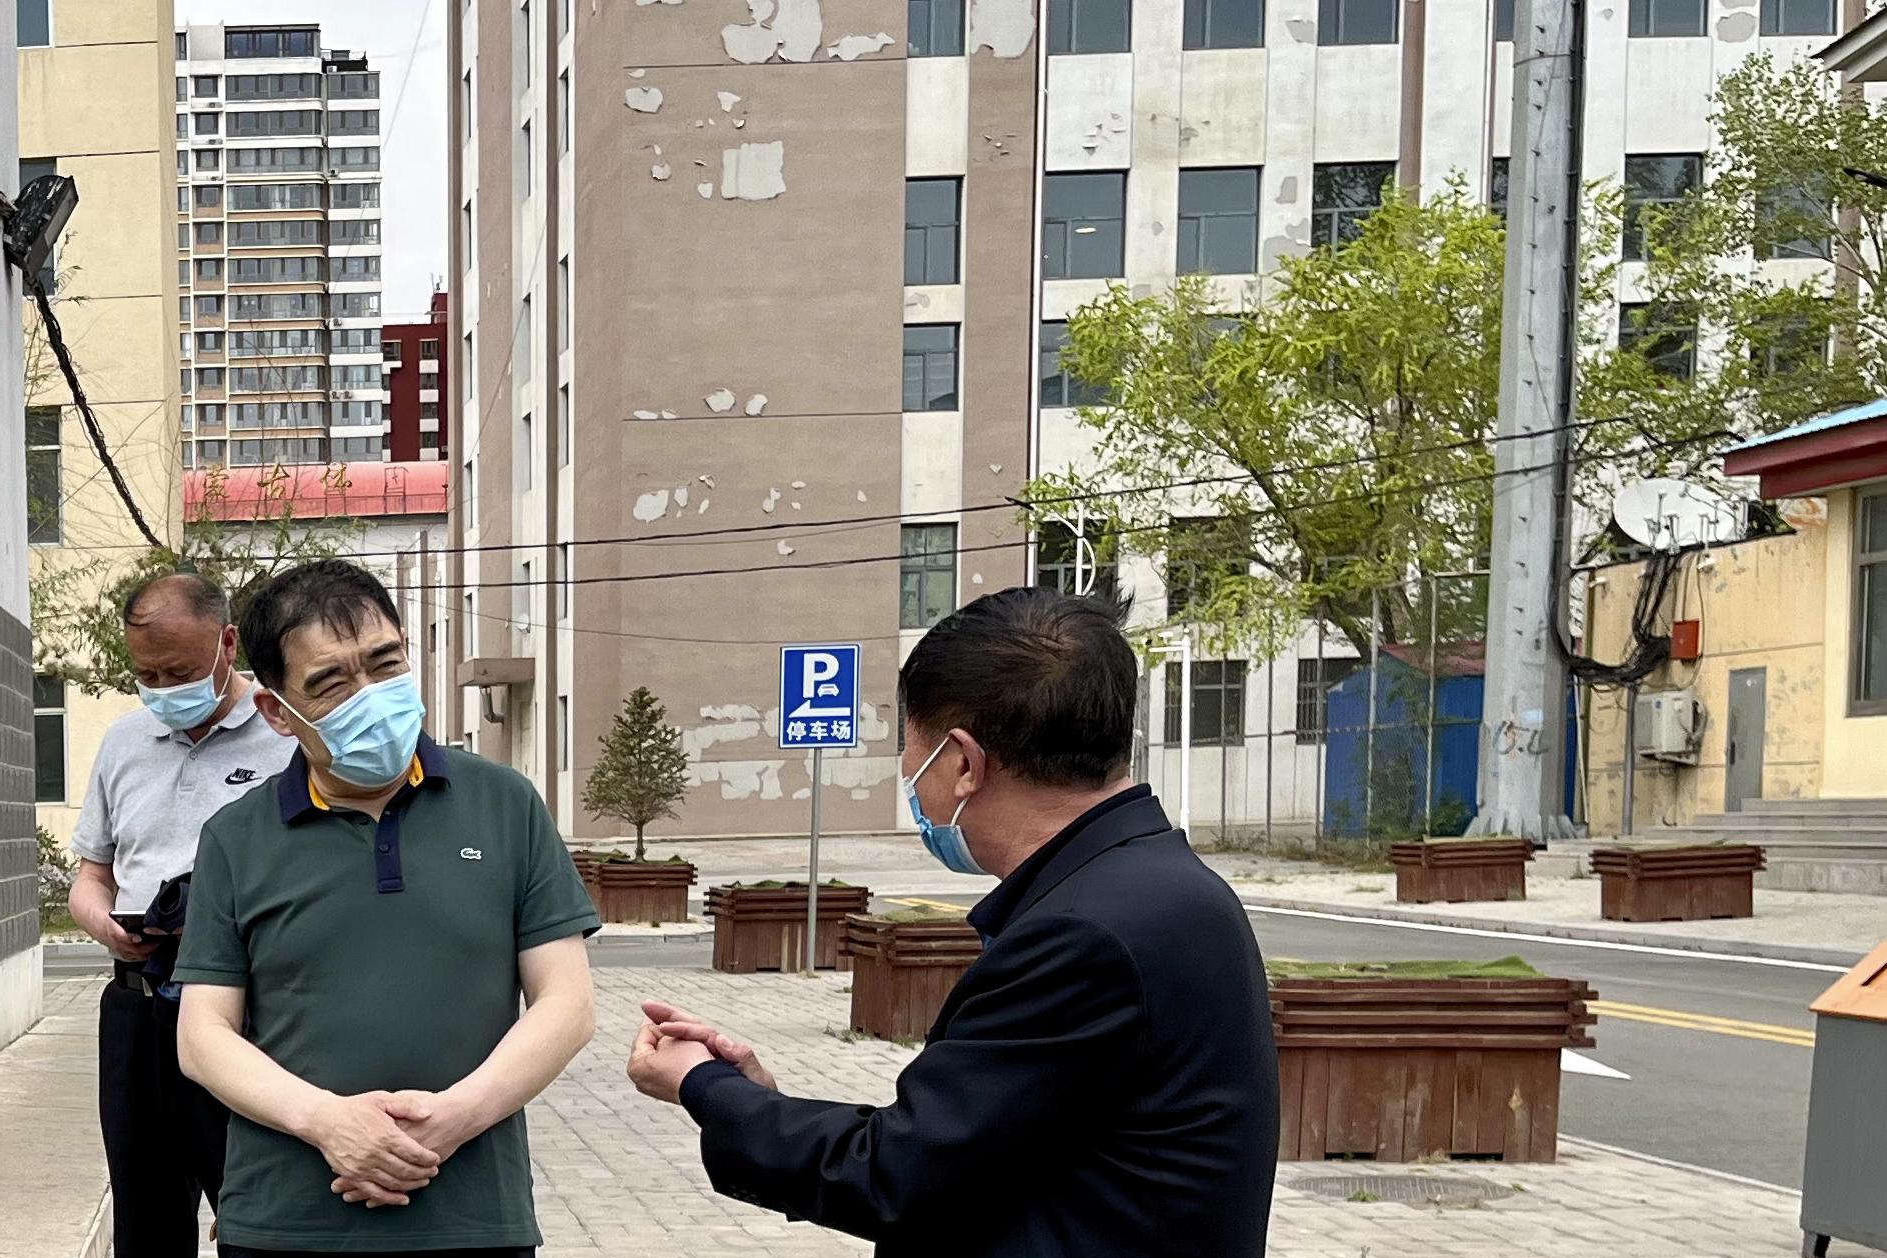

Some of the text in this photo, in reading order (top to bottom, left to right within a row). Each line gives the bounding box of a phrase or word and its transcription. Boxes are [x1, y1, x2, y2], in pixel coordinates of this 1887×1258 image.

[803, 652, 839, 698] P
[786, 720, 851, 741] 停车场
